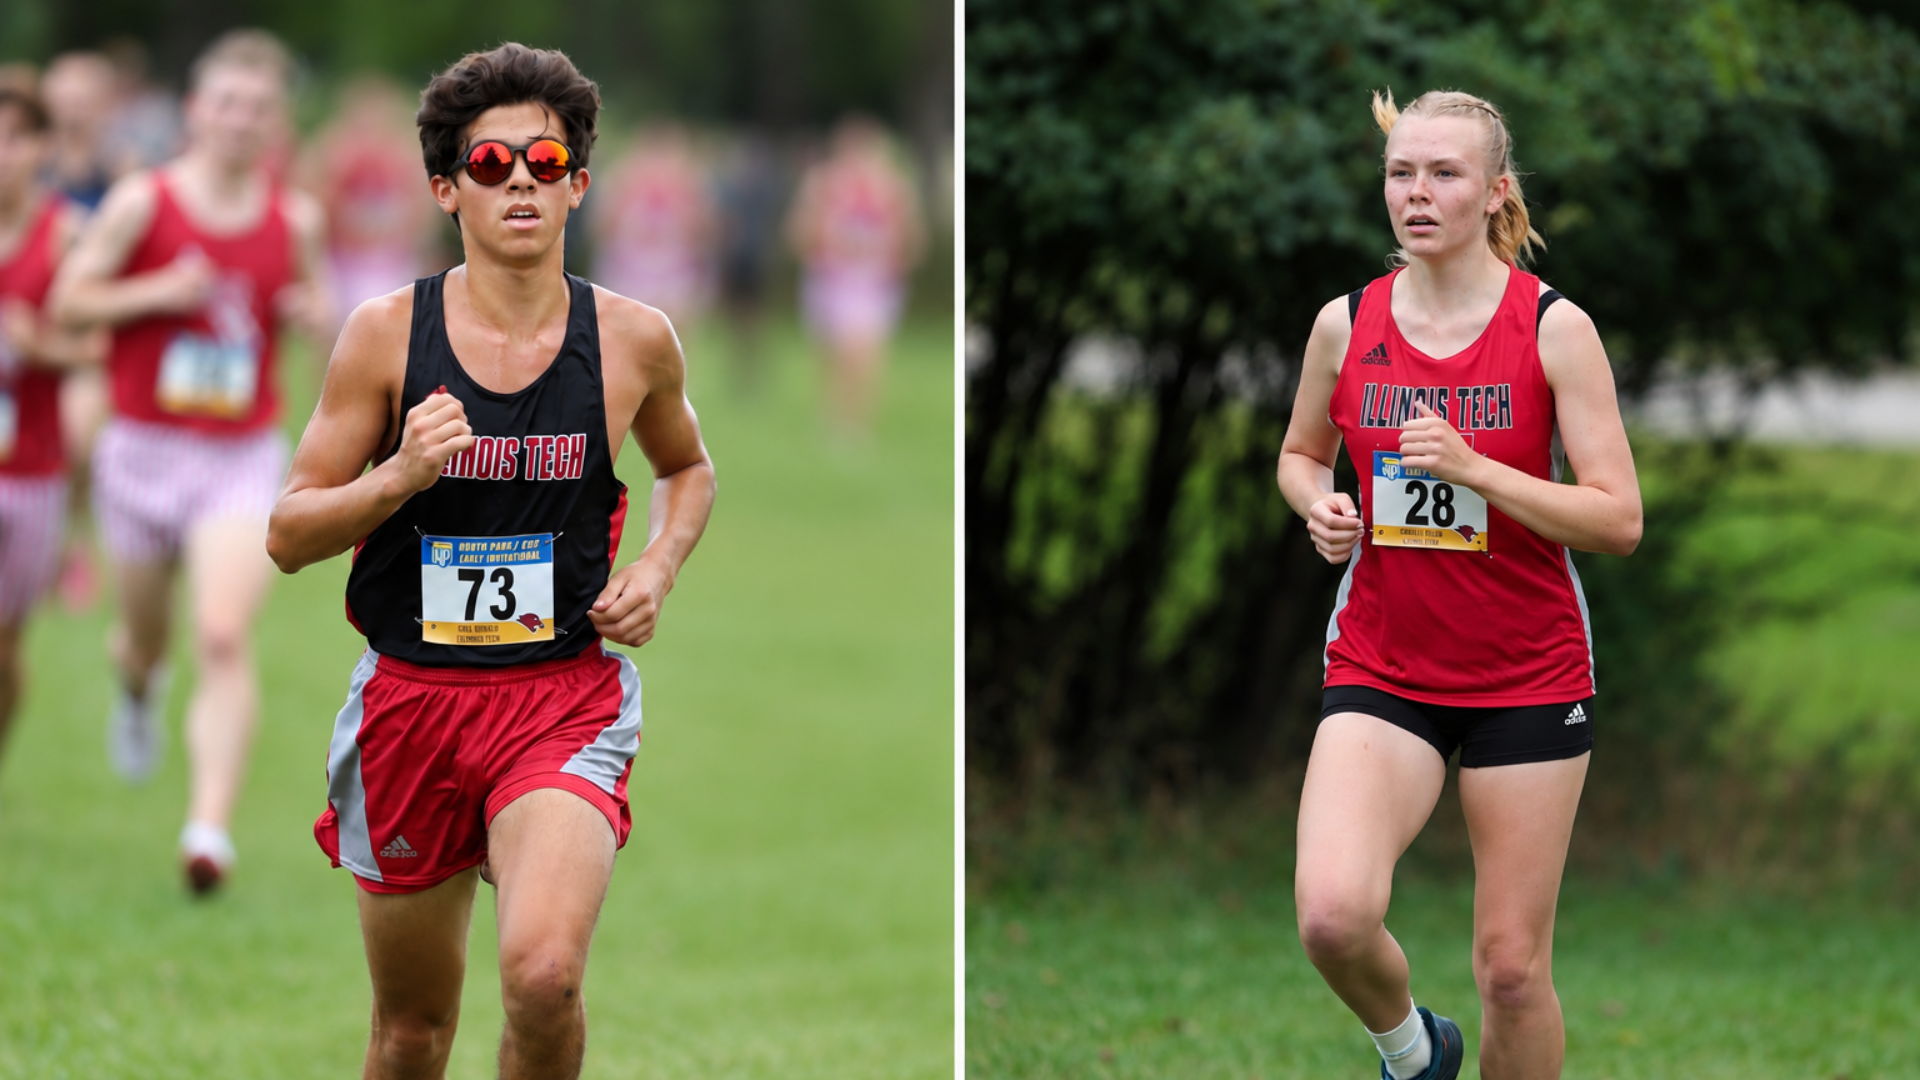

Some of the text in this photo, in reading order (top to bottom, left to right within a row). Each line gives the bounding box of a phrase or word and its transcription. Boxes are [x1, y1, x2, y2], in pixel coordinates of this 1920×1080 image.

[1456, 383, 1513, 430] TECH
[523, 433, 587, 481] TECH
[1405, 480, 1455, 528] 28
[457, 567, 517, 621] 73
